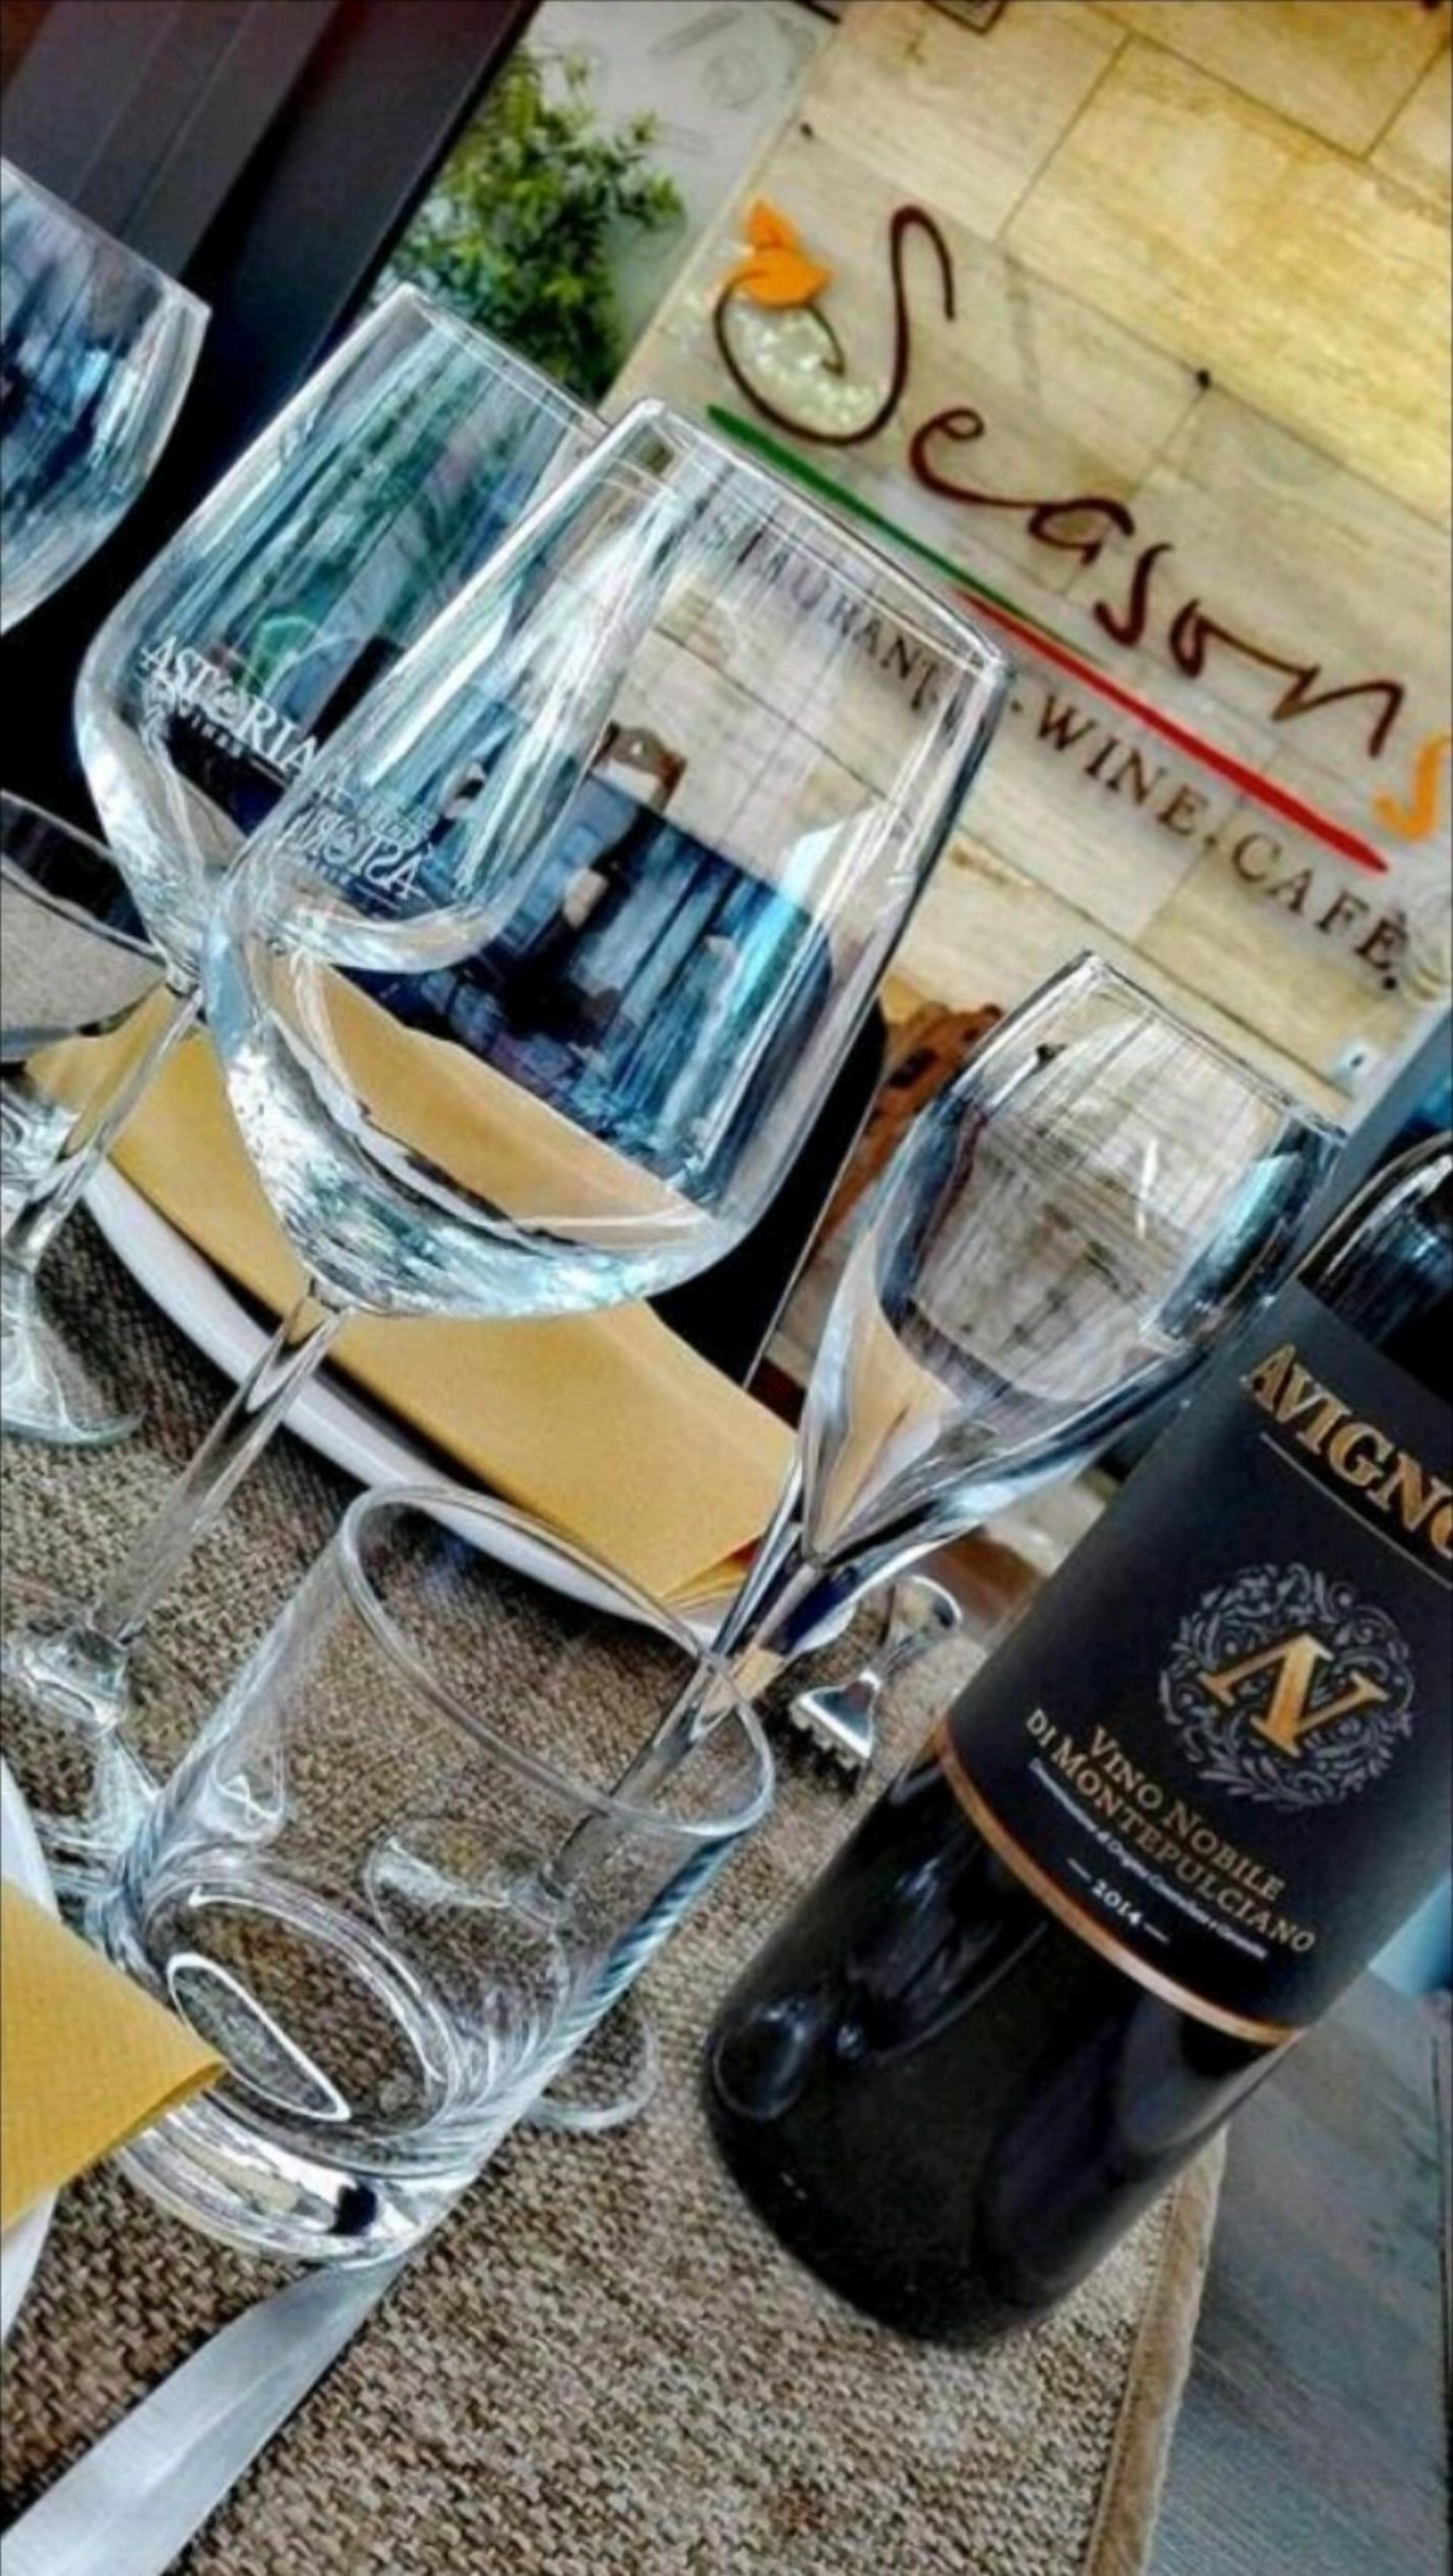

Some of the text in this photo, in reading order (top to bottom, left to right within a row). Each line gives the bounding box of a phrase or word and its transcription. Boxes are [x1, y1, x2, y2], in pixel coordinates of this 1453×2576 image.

[712, 205, 1451, 844] Seasons
[141, 636, 317, 780] ASTORIA
[1197, 1634, 1390, 1758] N
[1026, 1708, 1057, 1748] DI
[1050, 1734, 1315, 1951] MONTEPULCIANO
[1090, 1724, 1163, 1810] VINO
[1162, 1799, 1286, 1901] NOBILE
[1092, 1878, 1142, 1926] 2014
